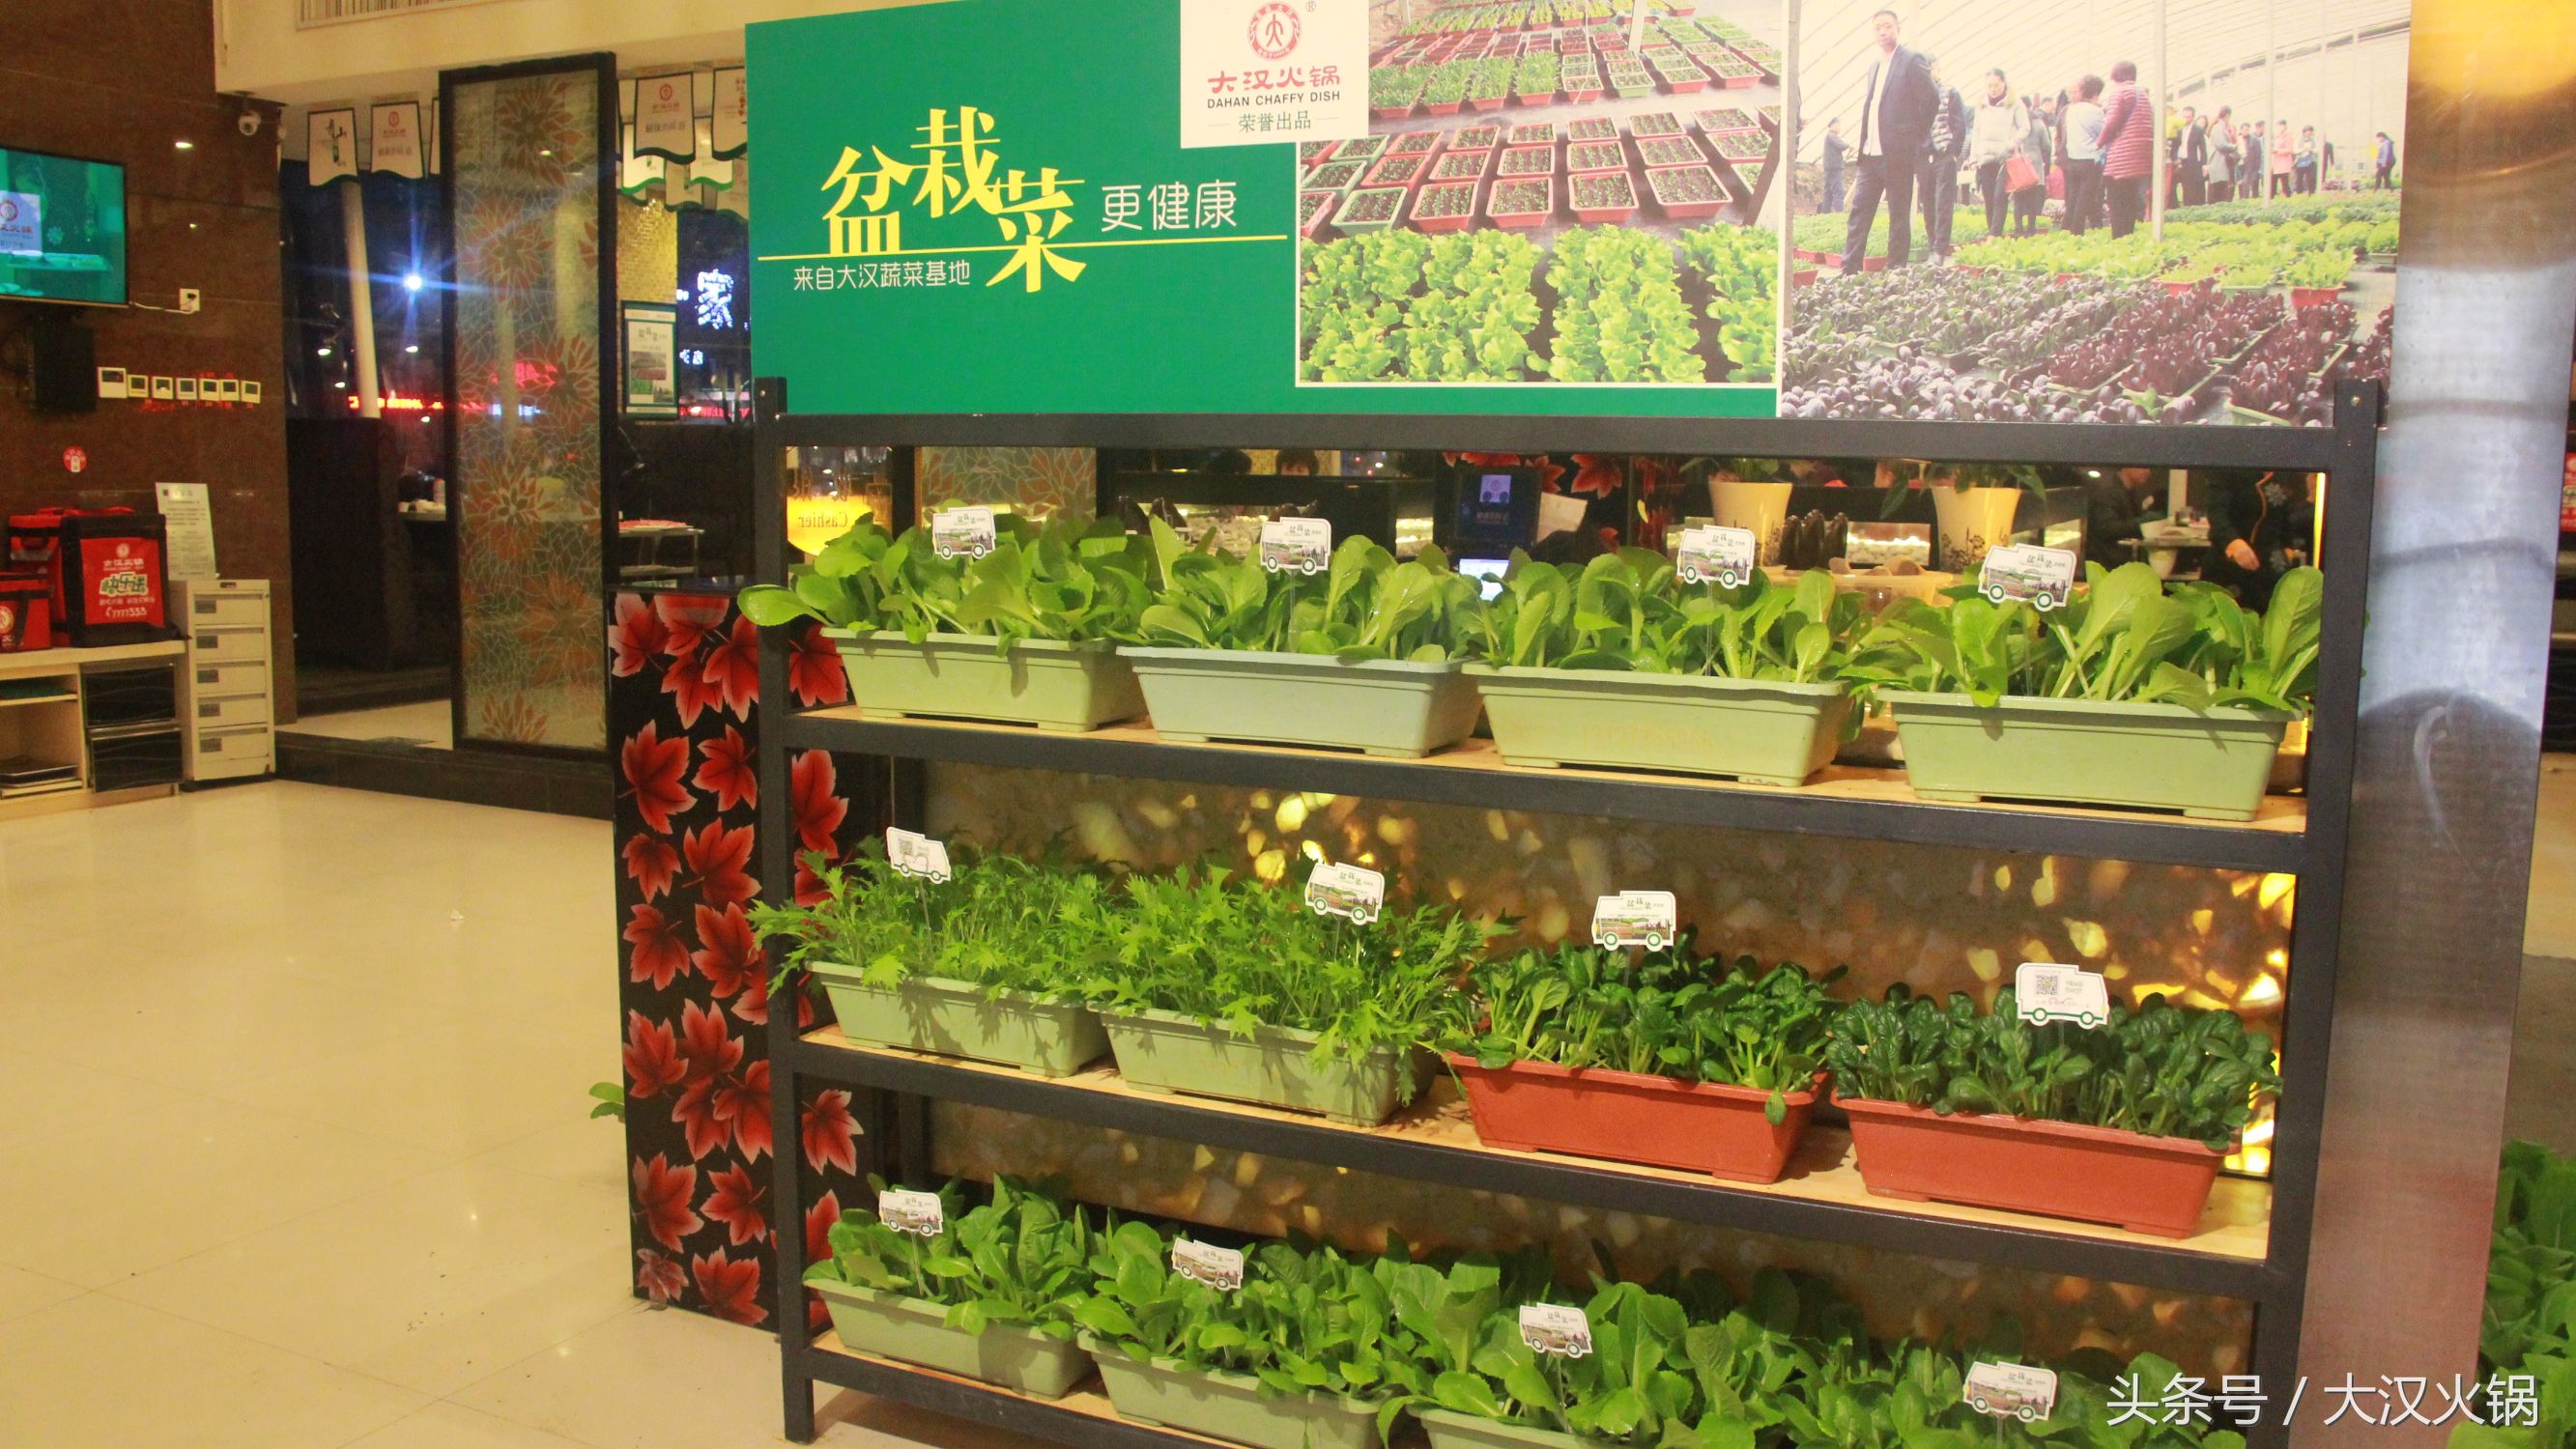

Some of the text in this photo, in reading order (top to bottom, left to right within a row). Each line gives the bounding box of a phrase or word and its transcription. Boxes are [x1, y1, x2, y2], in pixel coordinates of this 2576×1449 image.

[1208, 65, 1340, 94] 大汉火锅
[1208, 90, 1340, 109] DAHAN CHAFFY DISH
[1239, 110, 1311, 133] 荣誉出品
[820, 105, 1238, 294] 盆栽菜 更健康
[792, 259, 970, 291] 来自大汉蔬菜基地
